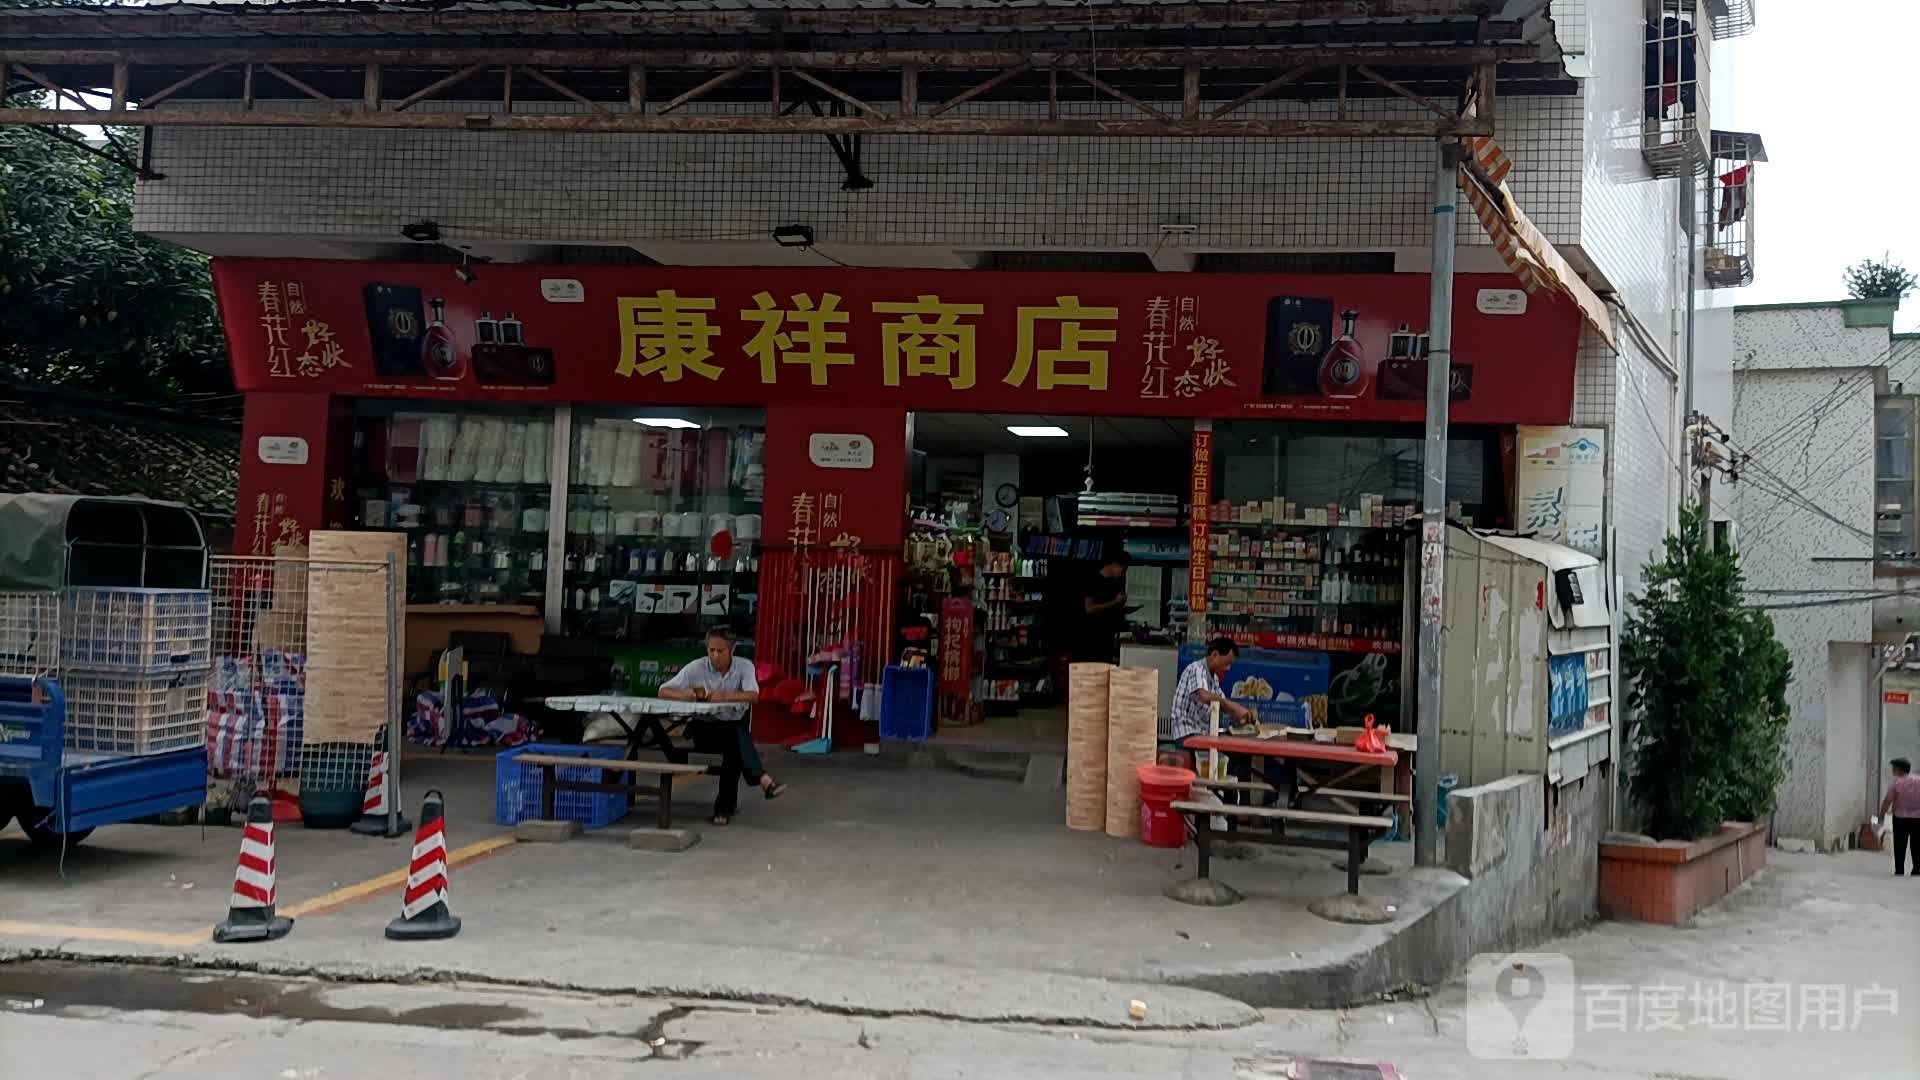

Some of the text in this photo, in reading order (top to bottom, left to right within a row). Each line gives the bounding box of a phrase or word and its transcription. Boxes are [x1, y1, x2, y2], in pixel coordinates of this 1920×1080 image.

[257, 281, 296, 377] 春花红
[287, 282, 305, 314] 自然
[1179, 296, 1195, 332] 自然
[615, 289, 1119, 391] 康祥商店
[1140, 296, 1172, 399] 春花红
[823, 492, 839, 529] 自然
